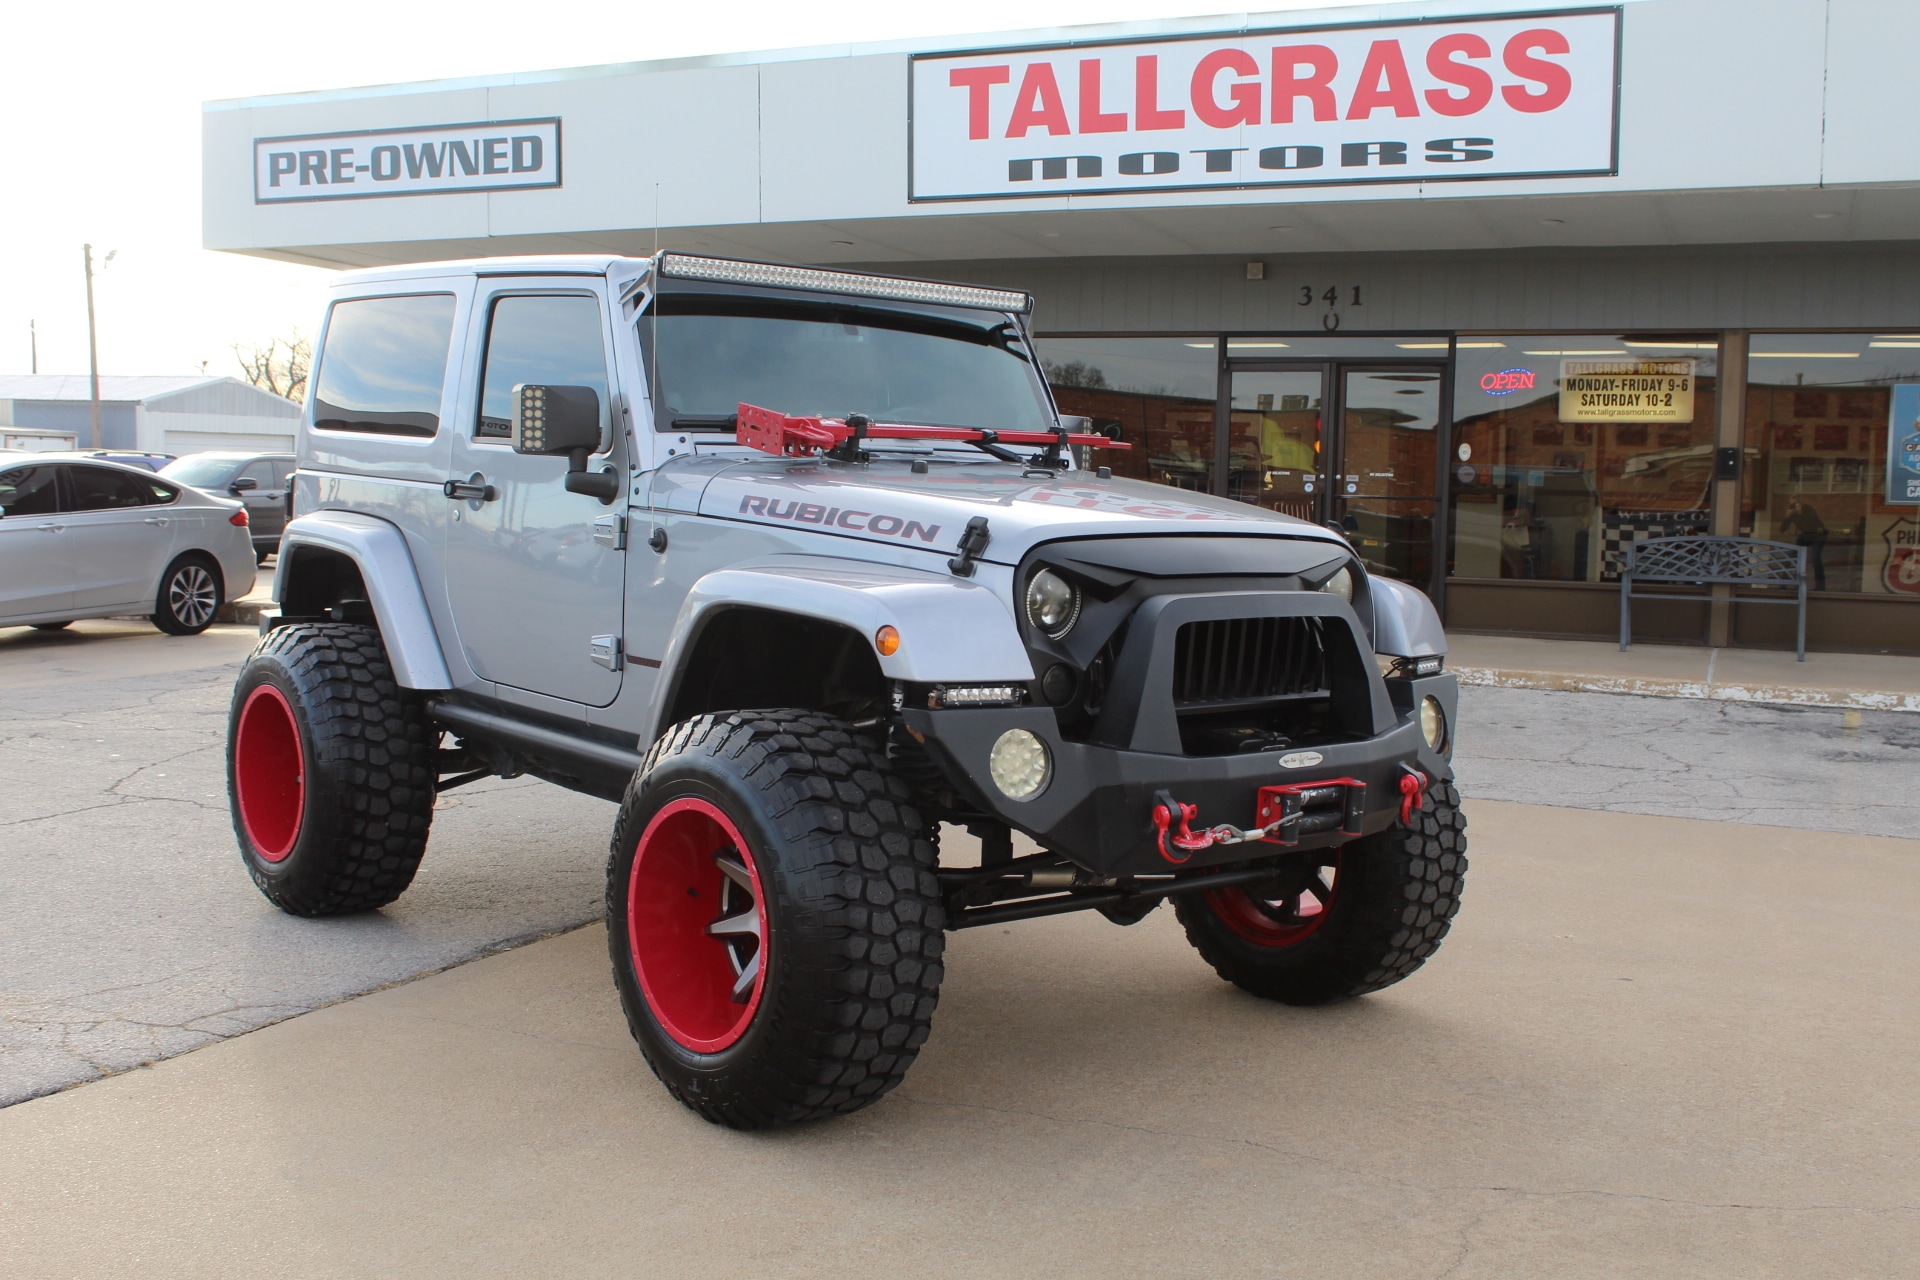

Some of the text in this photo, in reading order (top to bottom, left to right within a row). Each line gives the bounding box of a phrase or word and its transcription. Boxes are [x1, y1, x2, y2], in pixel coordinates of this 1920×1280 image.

[949, 28, 1572, 140] TALLGRASS
[269, 136, 543, 187] PRE-OWNED
[1298, 285, 1362, 306] 341
[1567, 362, 1689, 375] TALLGRASS MOTORS
[1480, 373, 1536, 389] OPEN
[1566, 378, 1689, 391] MONDAY-FRIDAY 9-6
[1581, 393, 1672, 406] SATURDAY 10-2
[1577, 409, 1676, 417] www.tallgrassmotors.com
[739, 494, 941, 543] RUBICON
[1617, 510, 1710, 521] WELCO
